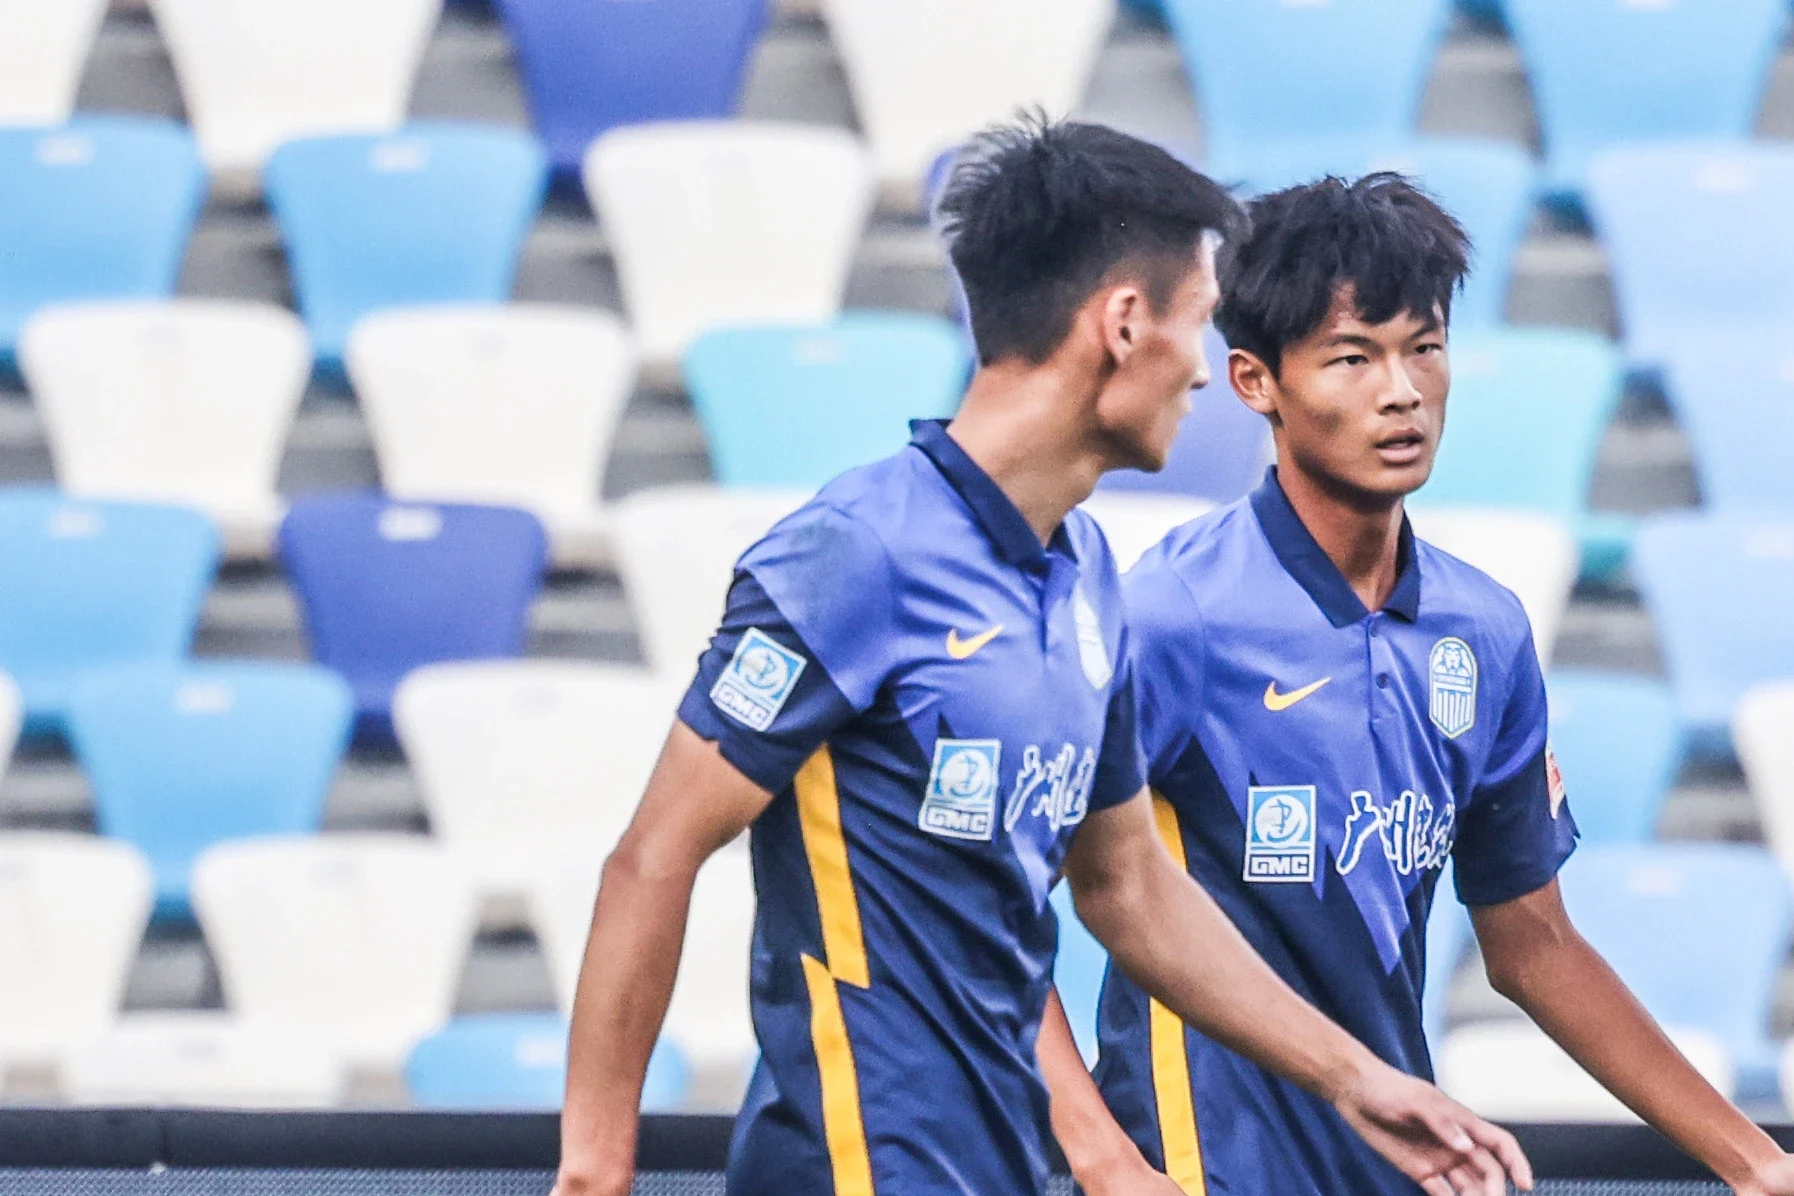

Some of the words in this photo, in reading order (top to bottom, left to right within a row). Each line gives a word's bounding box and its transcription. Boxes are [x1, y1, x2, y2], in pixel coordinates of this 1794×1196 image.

[715, 682, 772, 722] GMC
[928, 806, 988, 834] GMC
[1250, 855, 1310, 876] GMC
